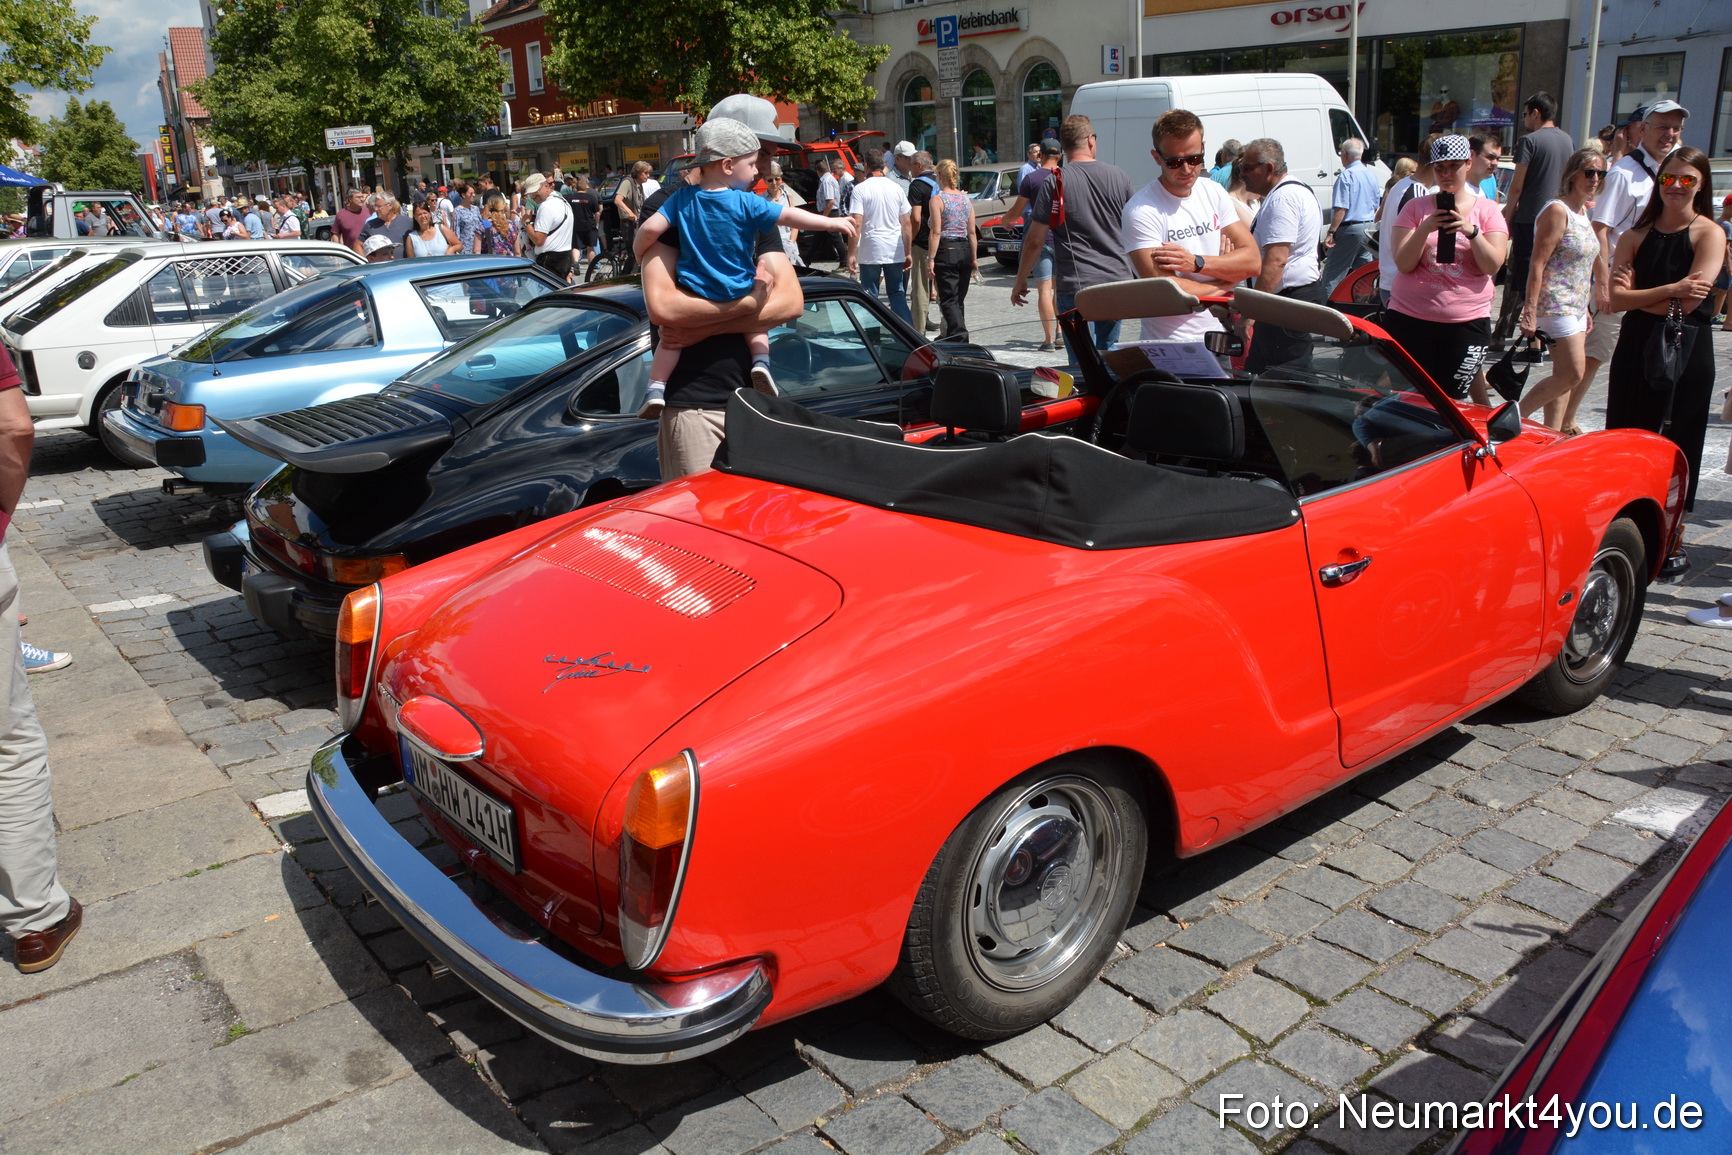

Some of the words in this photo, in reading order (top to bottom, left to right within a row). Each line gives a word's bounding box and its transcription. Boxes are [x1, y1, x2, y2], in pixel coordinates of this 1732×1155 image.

[941, 20, 952, 44] P
[1270, 2, 1366, 32] orsay
[159, 126, 175, 173] HOTEL
